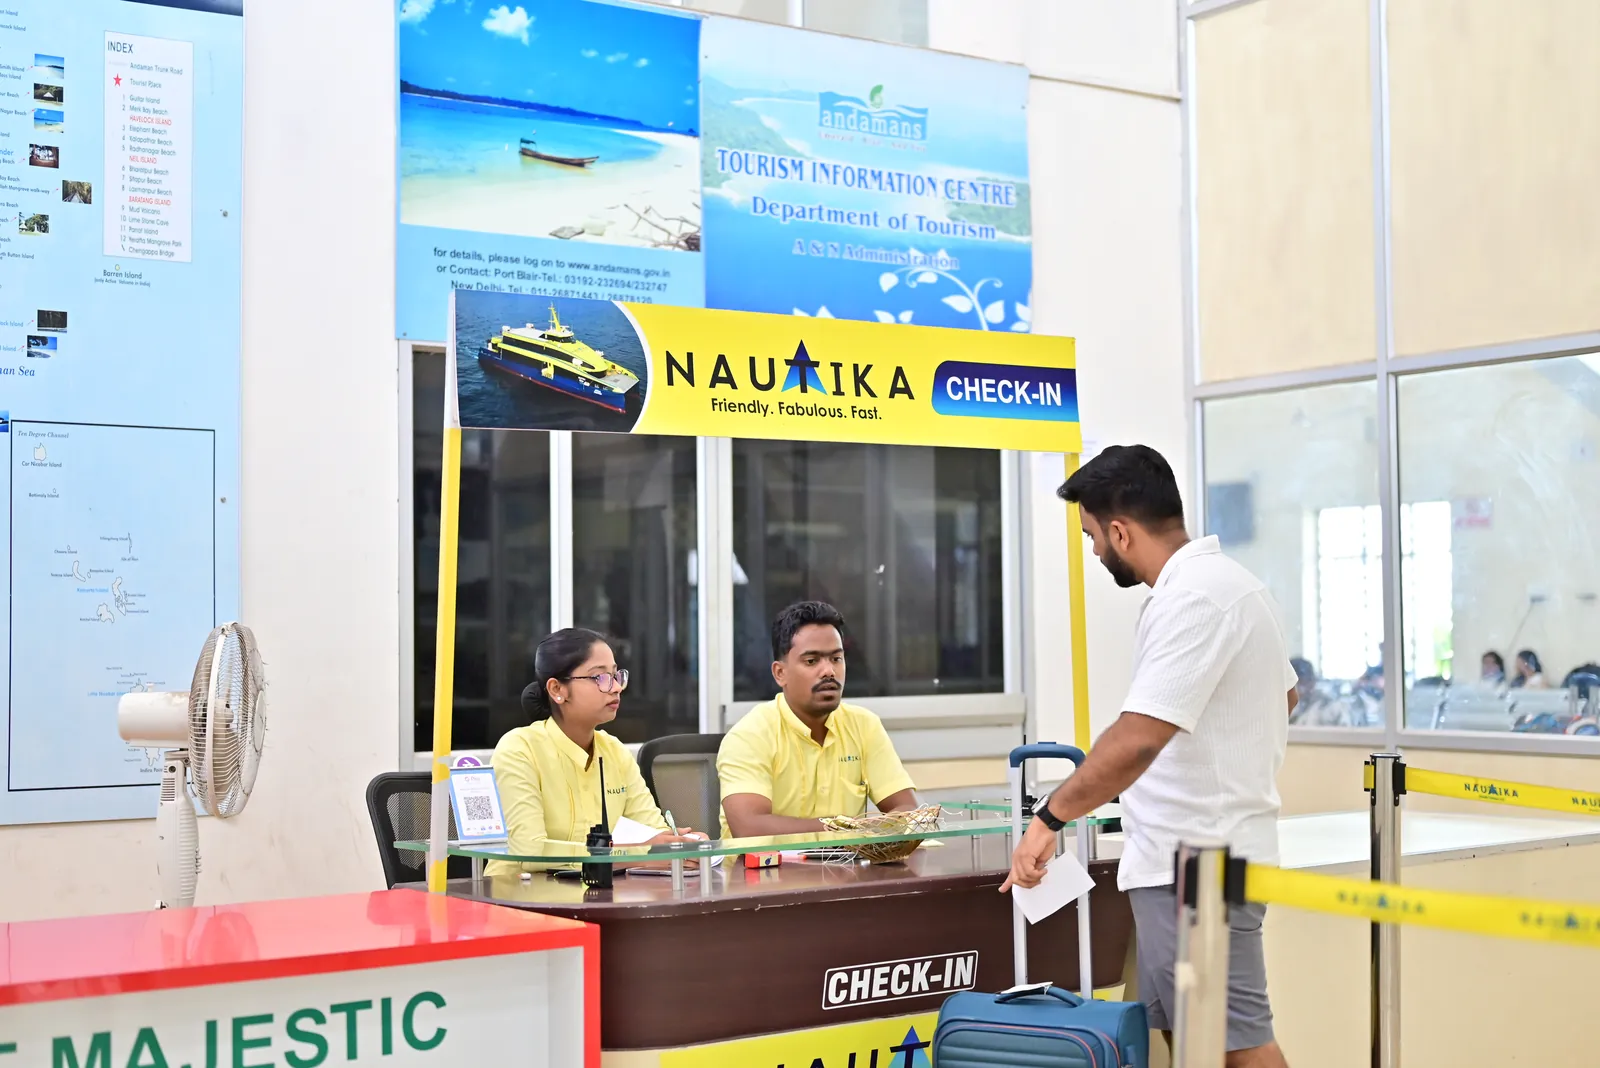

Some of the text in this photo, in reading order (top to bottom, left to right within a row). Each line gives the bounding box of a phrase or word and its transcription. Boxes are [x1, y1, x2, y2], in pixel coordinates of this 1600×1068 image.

[108, 41, 134, 54] INDEX
[130, 62, 153, 71] Andaman
[170, 67, 183, 75] Road
[130, 78, 147, 86] Tourist
[130, 115, 154, 124] HAVELOCK
[822, 108, 922, 140] andamans
[718, 149, 1015, 206] TOURISM INFORMATION CENTRE
[752, 196, 996, 240] Department of Tourism
[146, 238, 171, 246] Mangrove
[160, 249, 174, 258] Bridge
[793, 240, 960, 270] A & N Administration
[434, 247, 672, 278] for details, please log on to www.andamans.gov.in
[103, 270, 142, 280] Barren Island
[436, 265, 448, 274] or
[450, 264, 490, 278] Contact:
[494, 268, 514, 280] Port
[451, 280, 474, 290] New
[18, 366, 35, 376] Sea
[666, 339, 916, 400] NAUTIKA
[946, 376, 1062, 406] CHECK-IN
[711, 398, 882, 420] Friendly. Fabulous. Fast.
[1464, 783, 1518, 798] NAUTIKA
[1572, 796, 1600, 808] NAU
[828, 955, 974, 1004] CHECK-IN
[52, 991, 448, 1068] MAJESTIC
